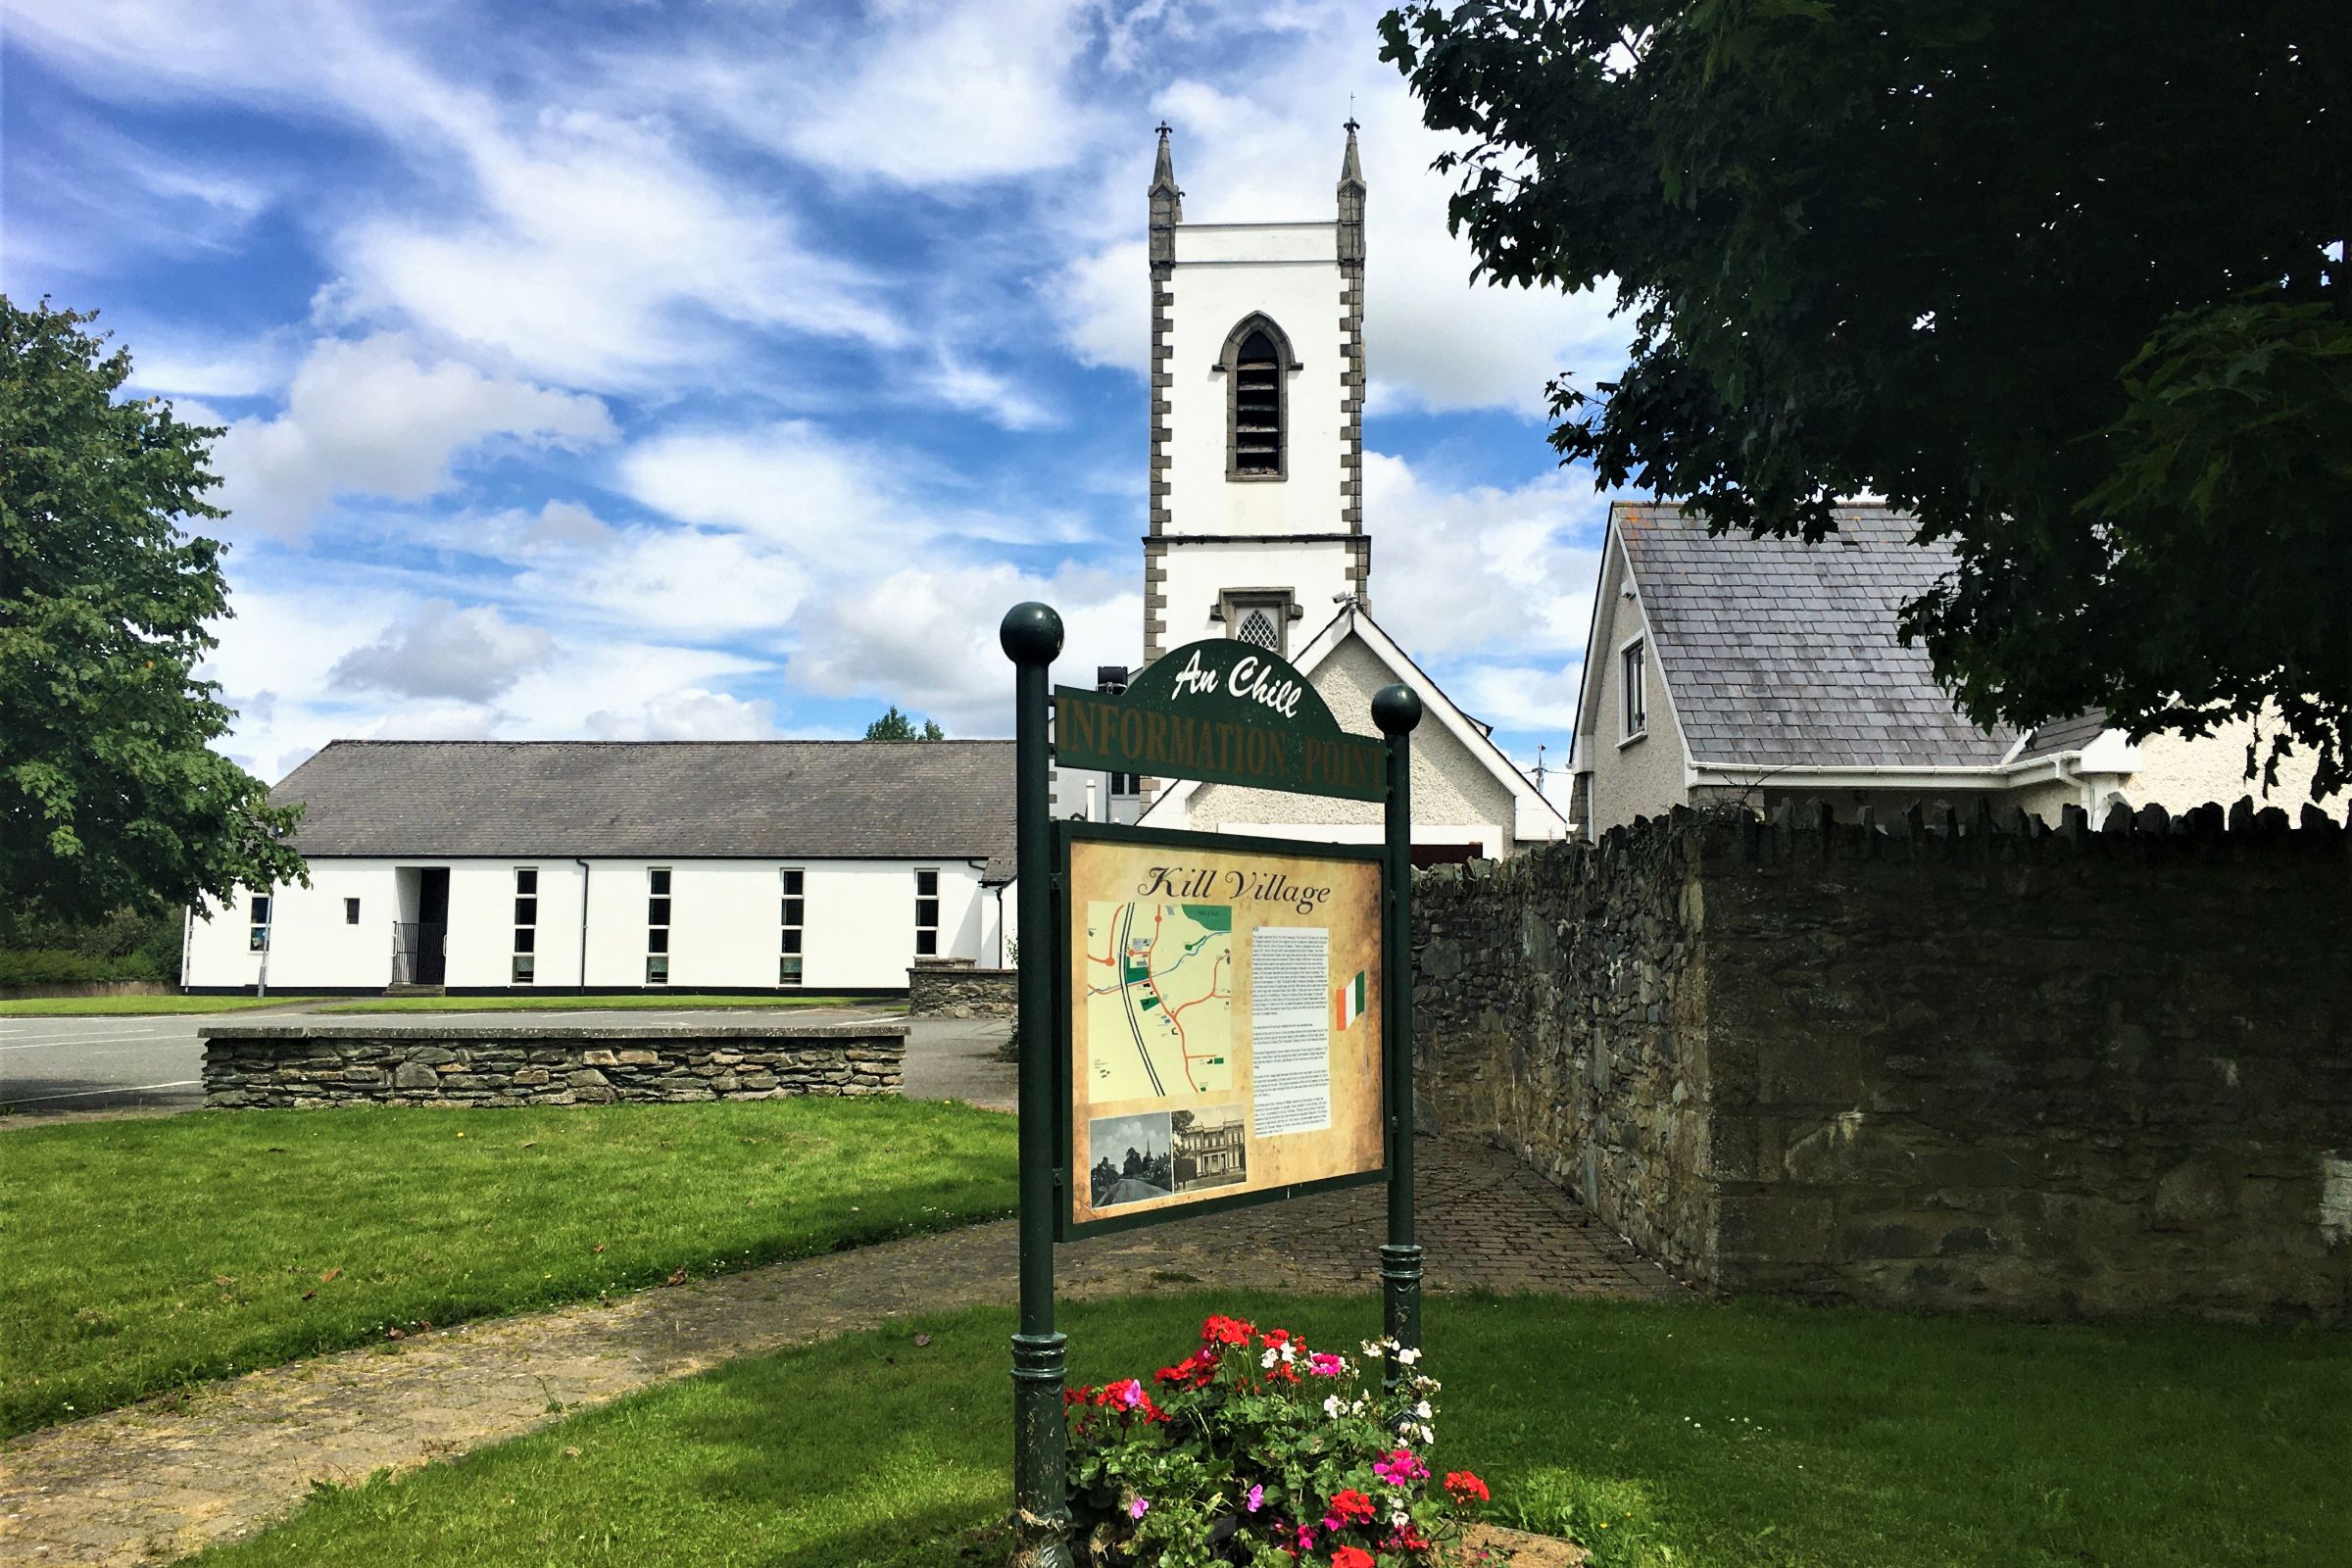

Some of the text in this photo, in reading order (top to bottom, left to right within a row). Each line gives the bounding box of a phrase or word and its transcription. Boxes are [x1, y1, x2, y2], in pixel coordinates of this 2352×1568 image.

[1171, 649, 1302, 718] An Chill
[1055, 697, 1385, 789] INFORMATION POINT
[1137, 866, 1332, 914] Kill Village
